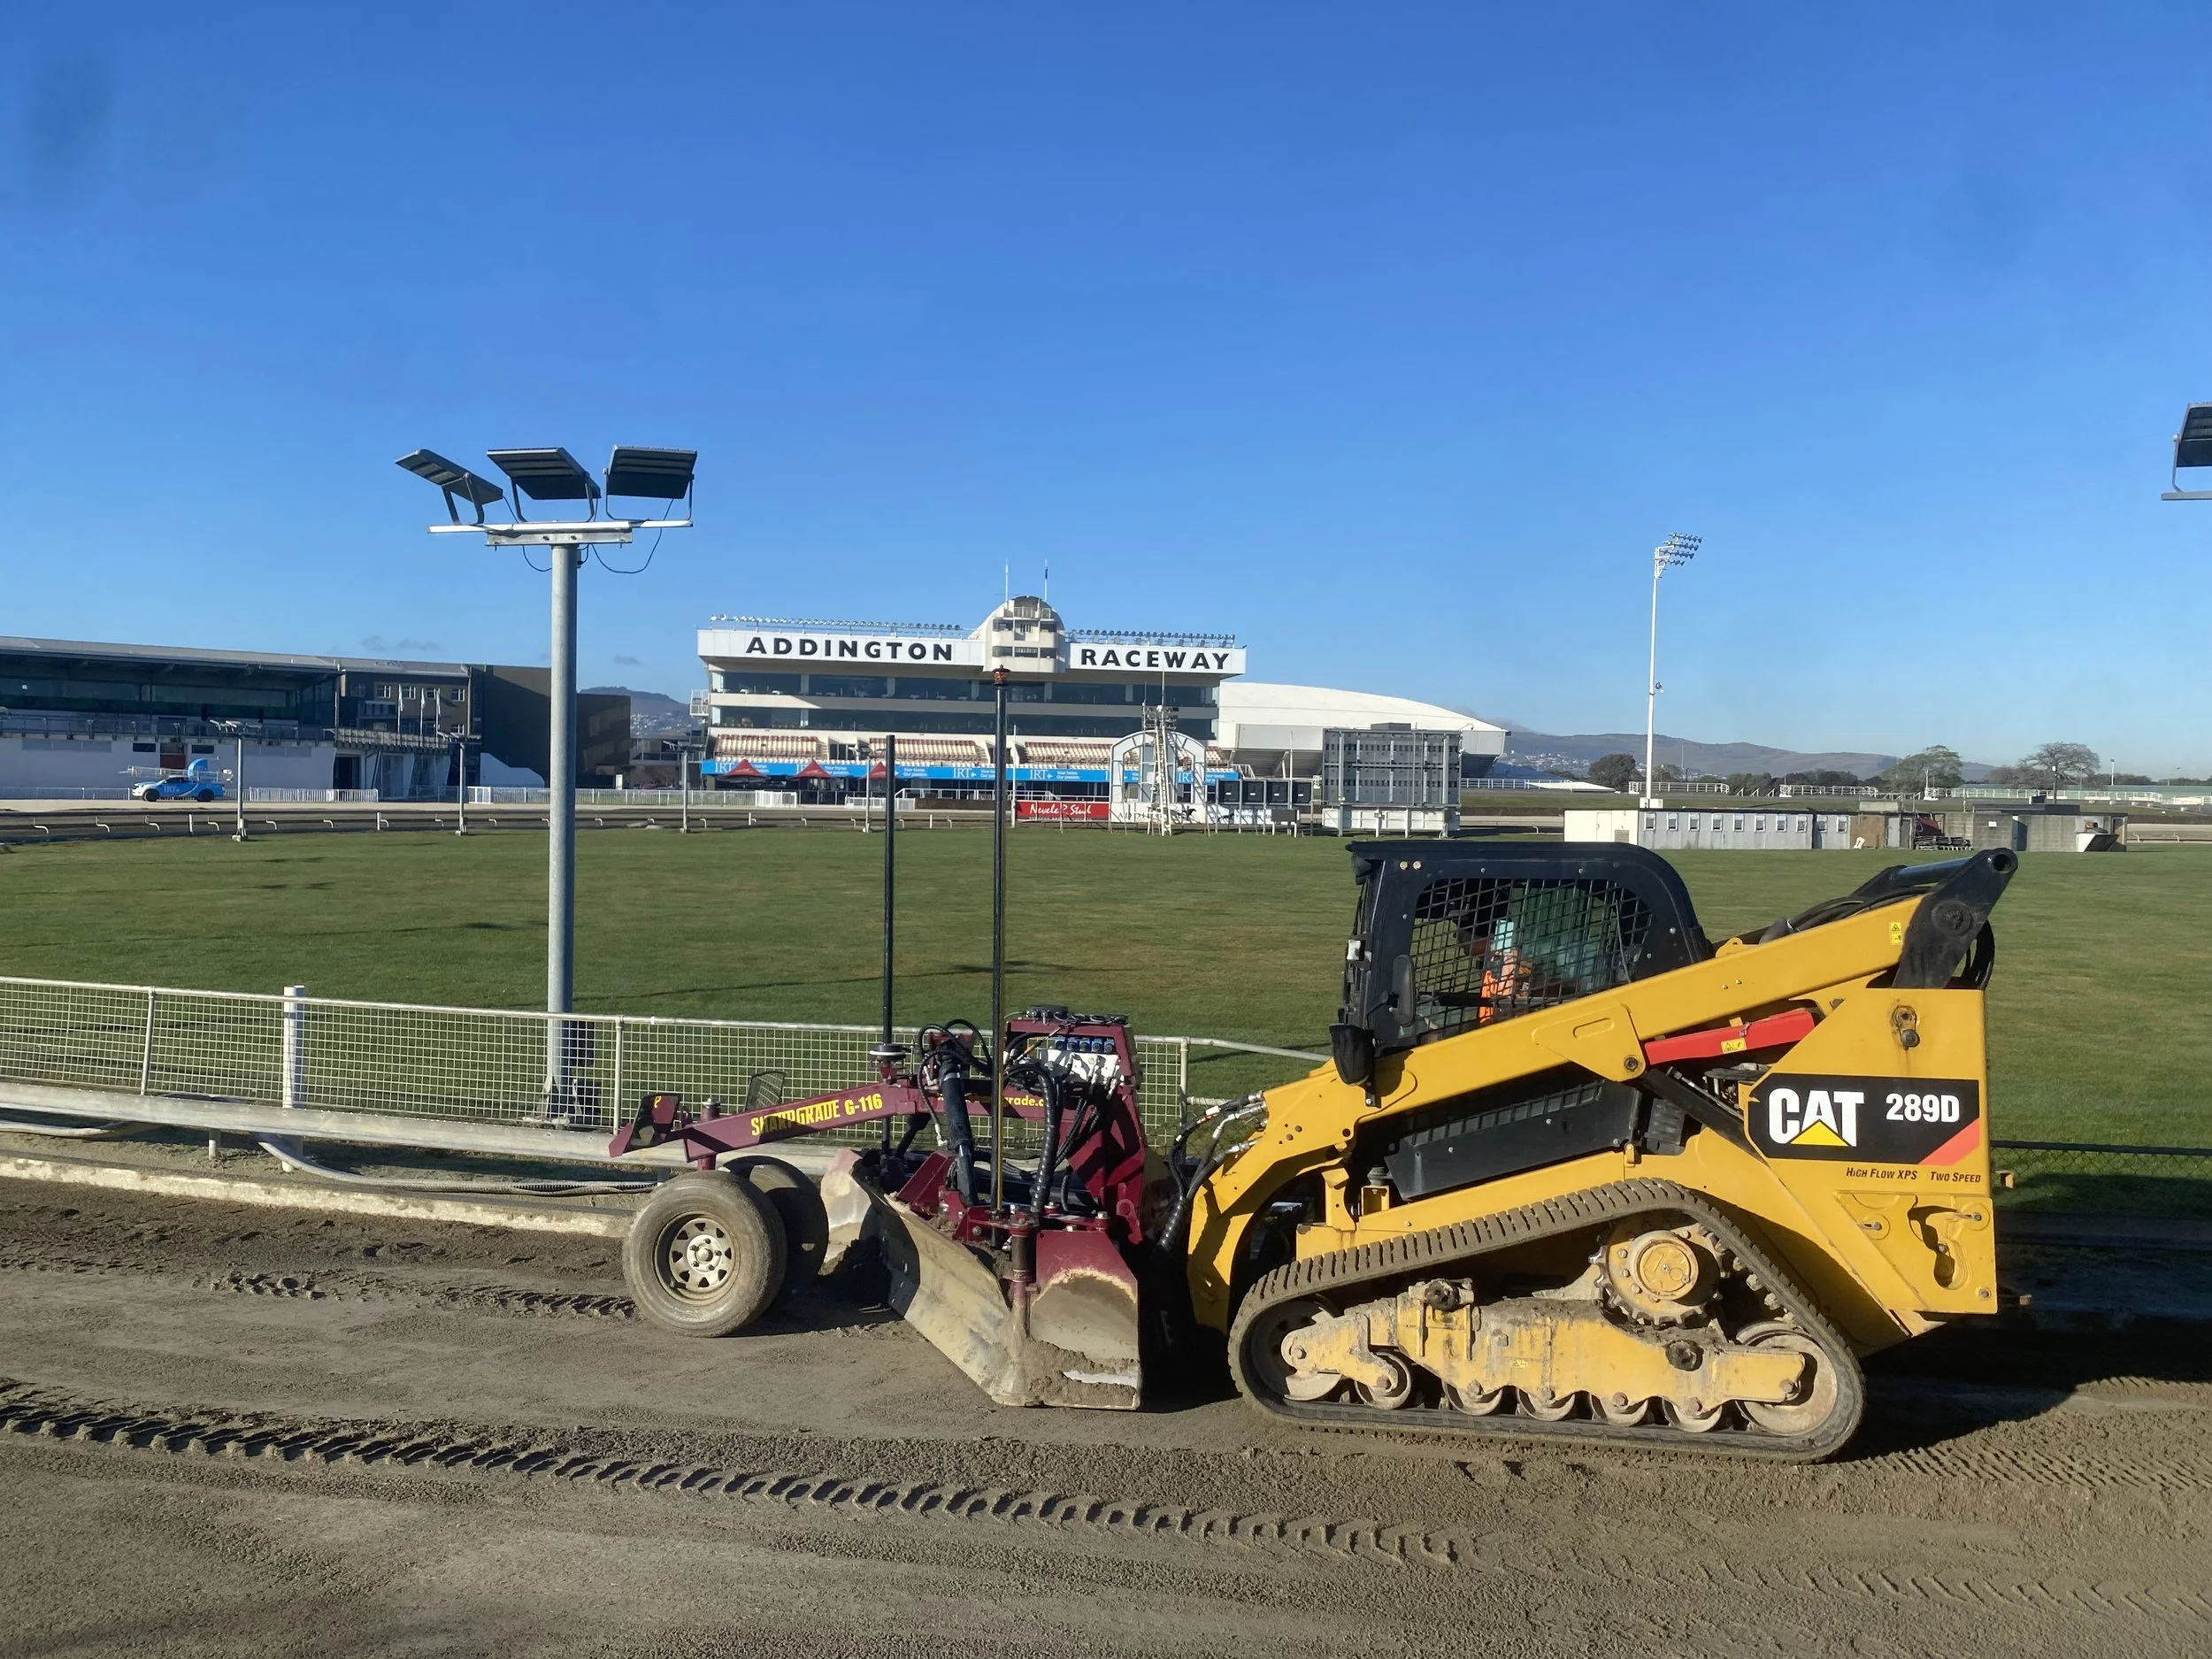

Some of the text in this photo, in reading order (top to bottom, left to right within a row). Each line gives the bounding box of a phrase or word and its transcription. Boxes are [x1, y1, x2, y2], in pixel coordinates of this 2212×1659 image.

[745, 637, 1230, 670] ADDINGTON RACEWAY
[953, 767, 972, 778] IRT
[1030, 769, 1048, 779] IRT
[1029, 803, 1060, 814] Nevele
[844, 1093, 883, 1116] G-116
[1886, 1093, 1960, 1123] 289D
[1769, 1087, 1864, 1147] CAT
[1897, 1170, 1918, 1180] XPS
